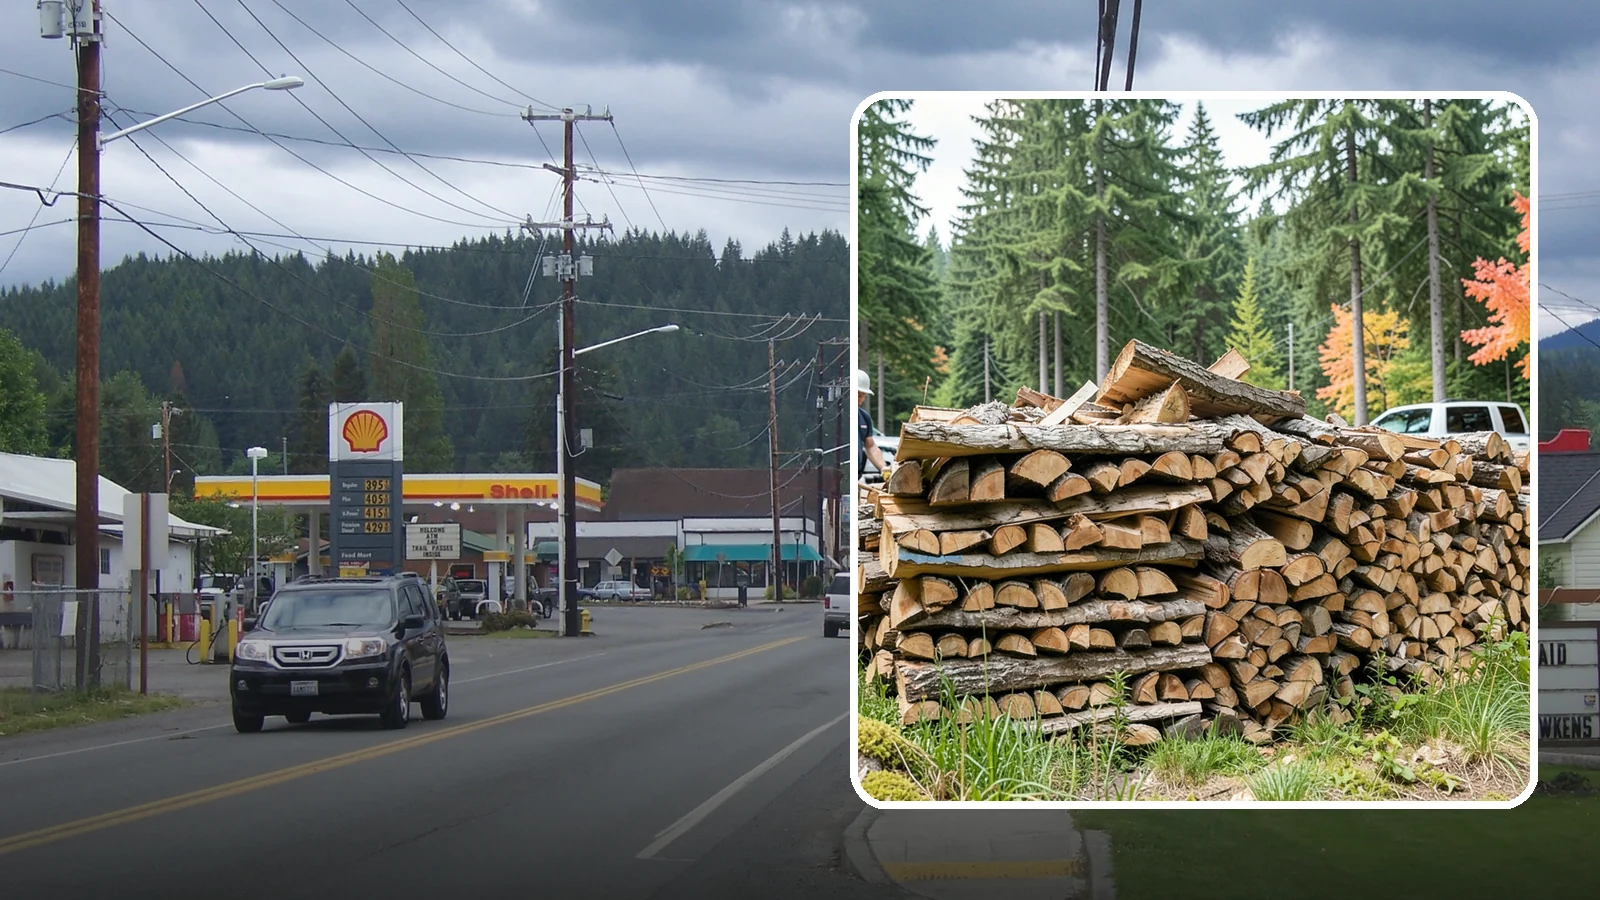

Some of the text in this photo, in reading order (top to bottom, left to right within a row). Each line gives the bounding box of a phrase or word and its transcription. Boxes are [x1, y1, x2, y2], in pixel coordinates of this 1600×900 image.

[366, 480, 383, 490] 395
[490, 484, 547, 499] Shell
[366, 494, 383, 504] 405
[366, 508, 383, 518] 415
[366, 522, 383, 532] 429
[1538, 643, 1567, 665] AID
[1538, 716, 1592, 739] WKENS
